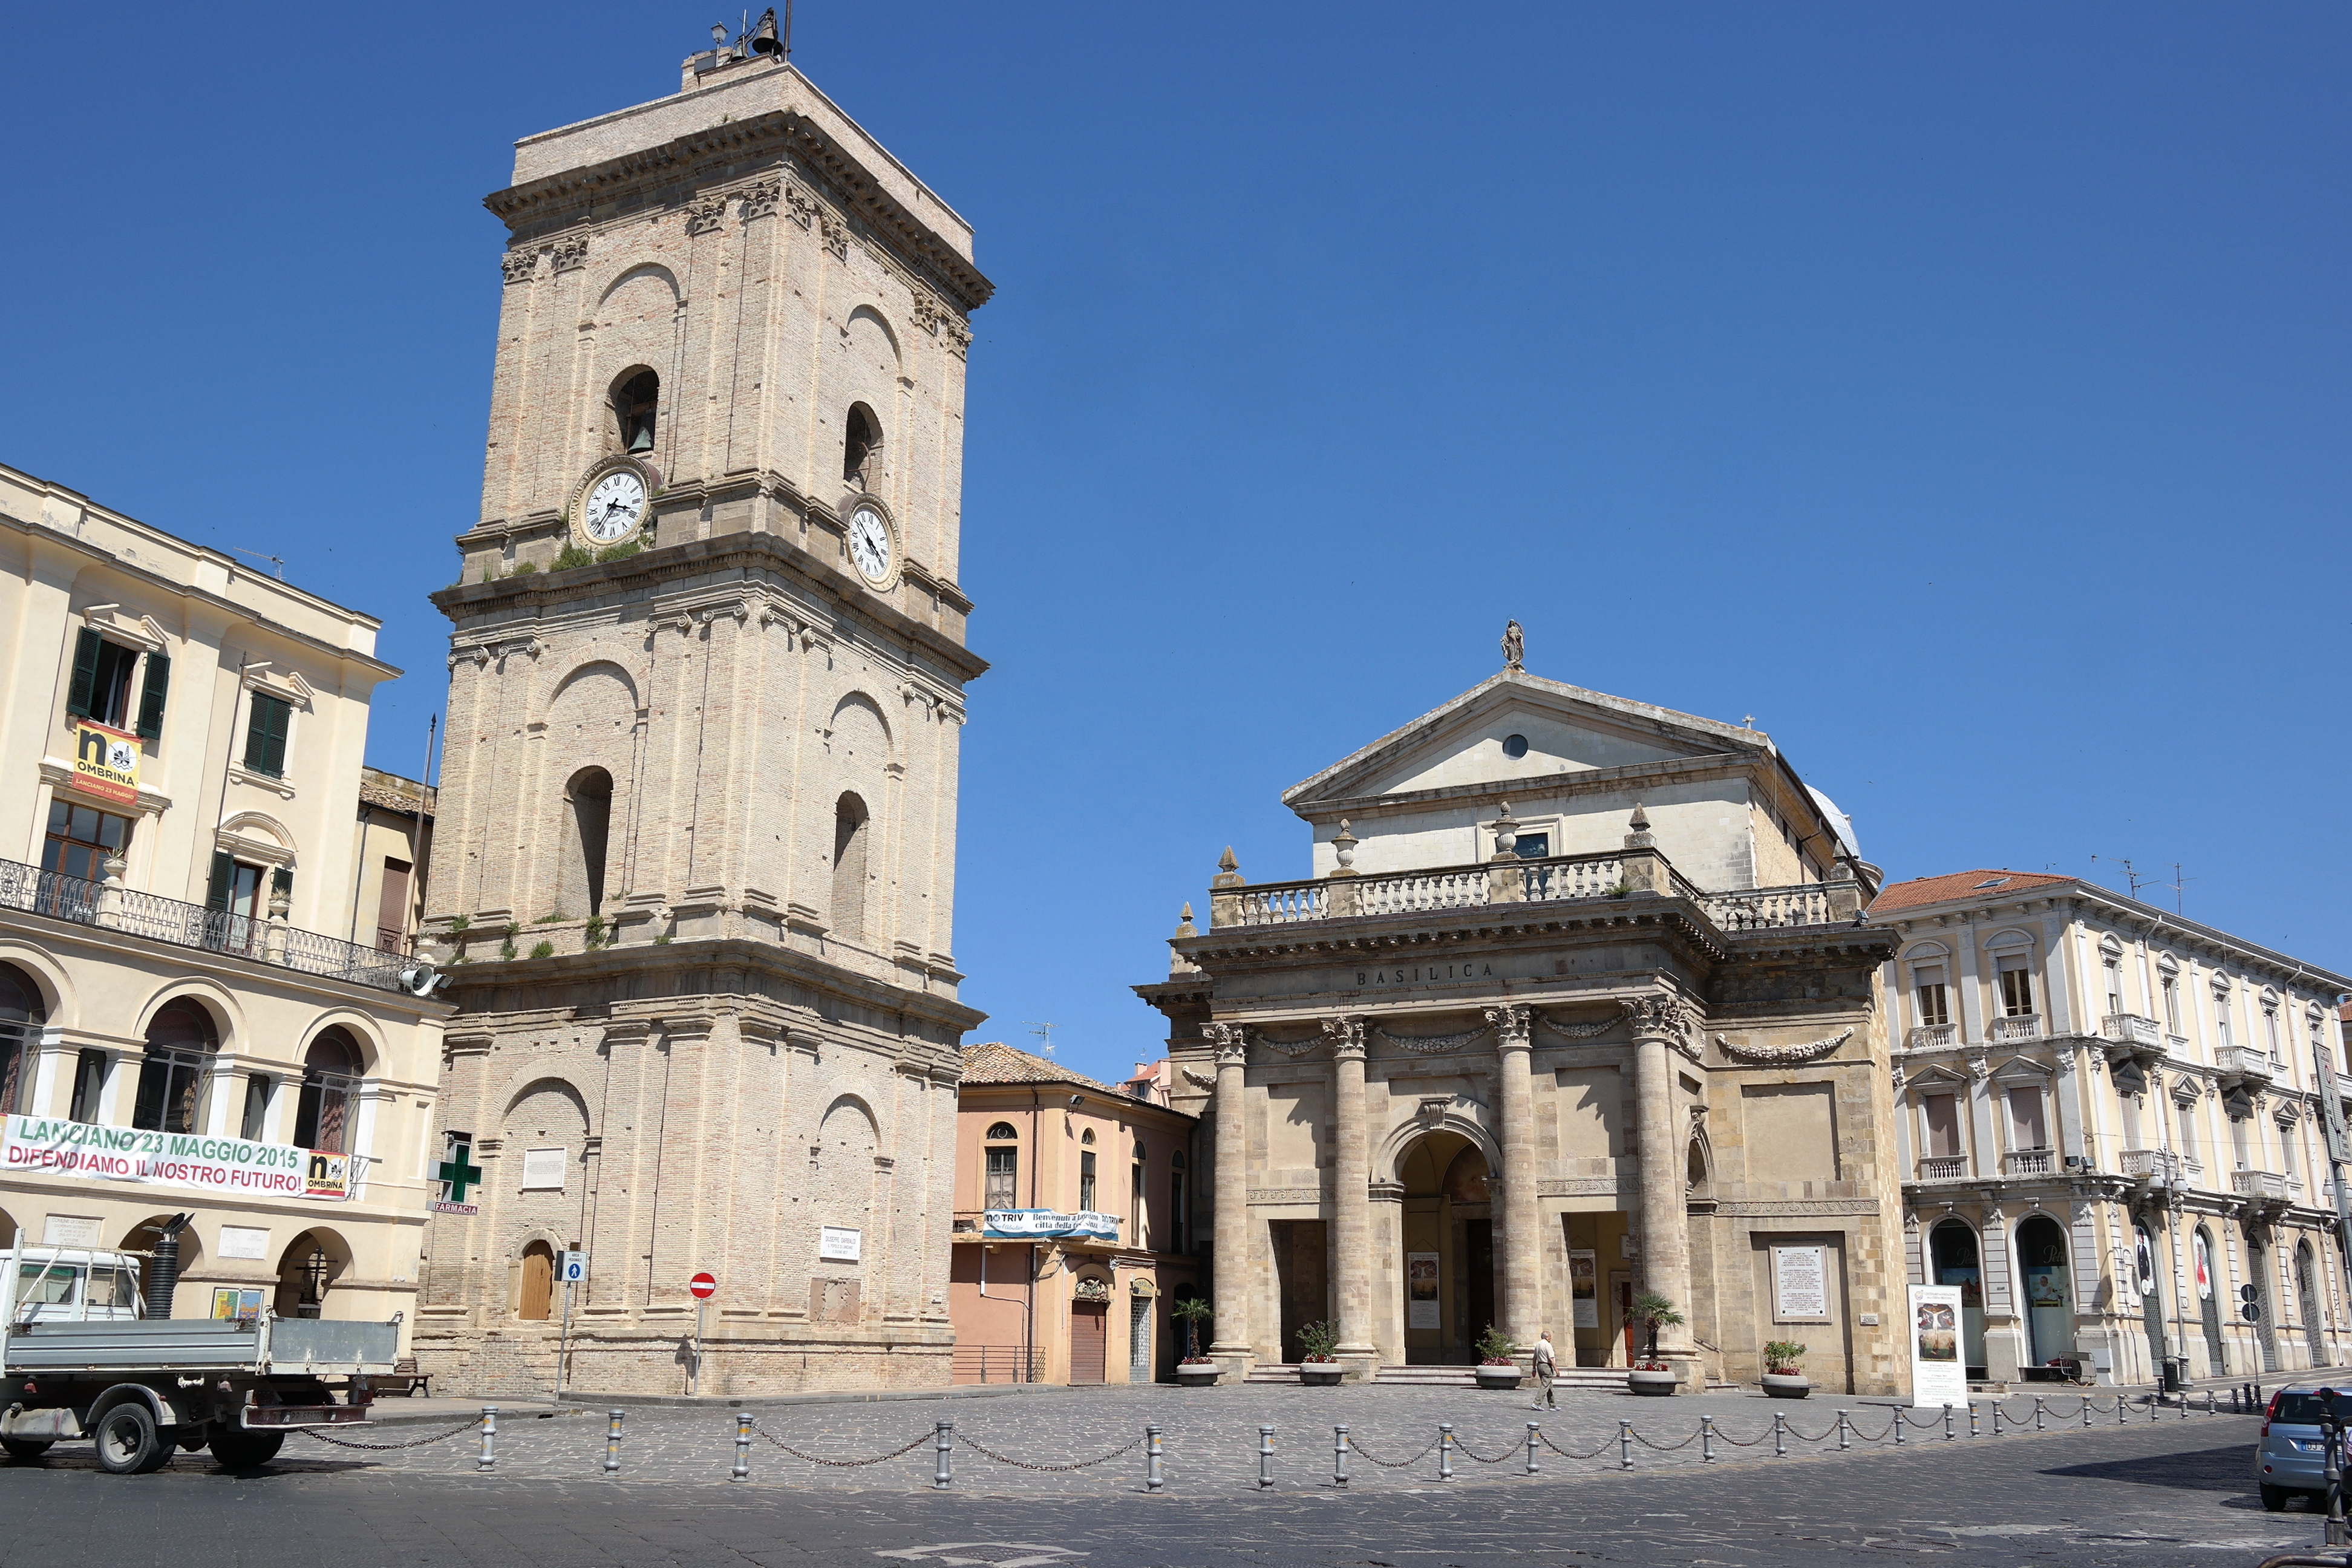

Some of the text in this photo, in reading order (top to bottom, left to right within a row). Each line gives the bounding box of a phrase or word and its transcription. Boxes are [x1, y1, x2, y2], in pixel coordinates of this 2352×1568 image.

[77, 762, 135, 786] OMBRINA
[76, 778, 105, 791] LANCIANO
[113, 789, 134, 800] MAGGIO
[1357, 964, 1492, 985] BASILICA
[19, 1119, 298, 1169] LANCIANO 23 MAGGIO 2015
[8, 1146, 301, 1191] DIFENDIAMO IL NOSTRO FUTURO!
[308, 1180, 343, 1189] OMBRINA
[436, 1203, 477, 1214] FARMACIA
